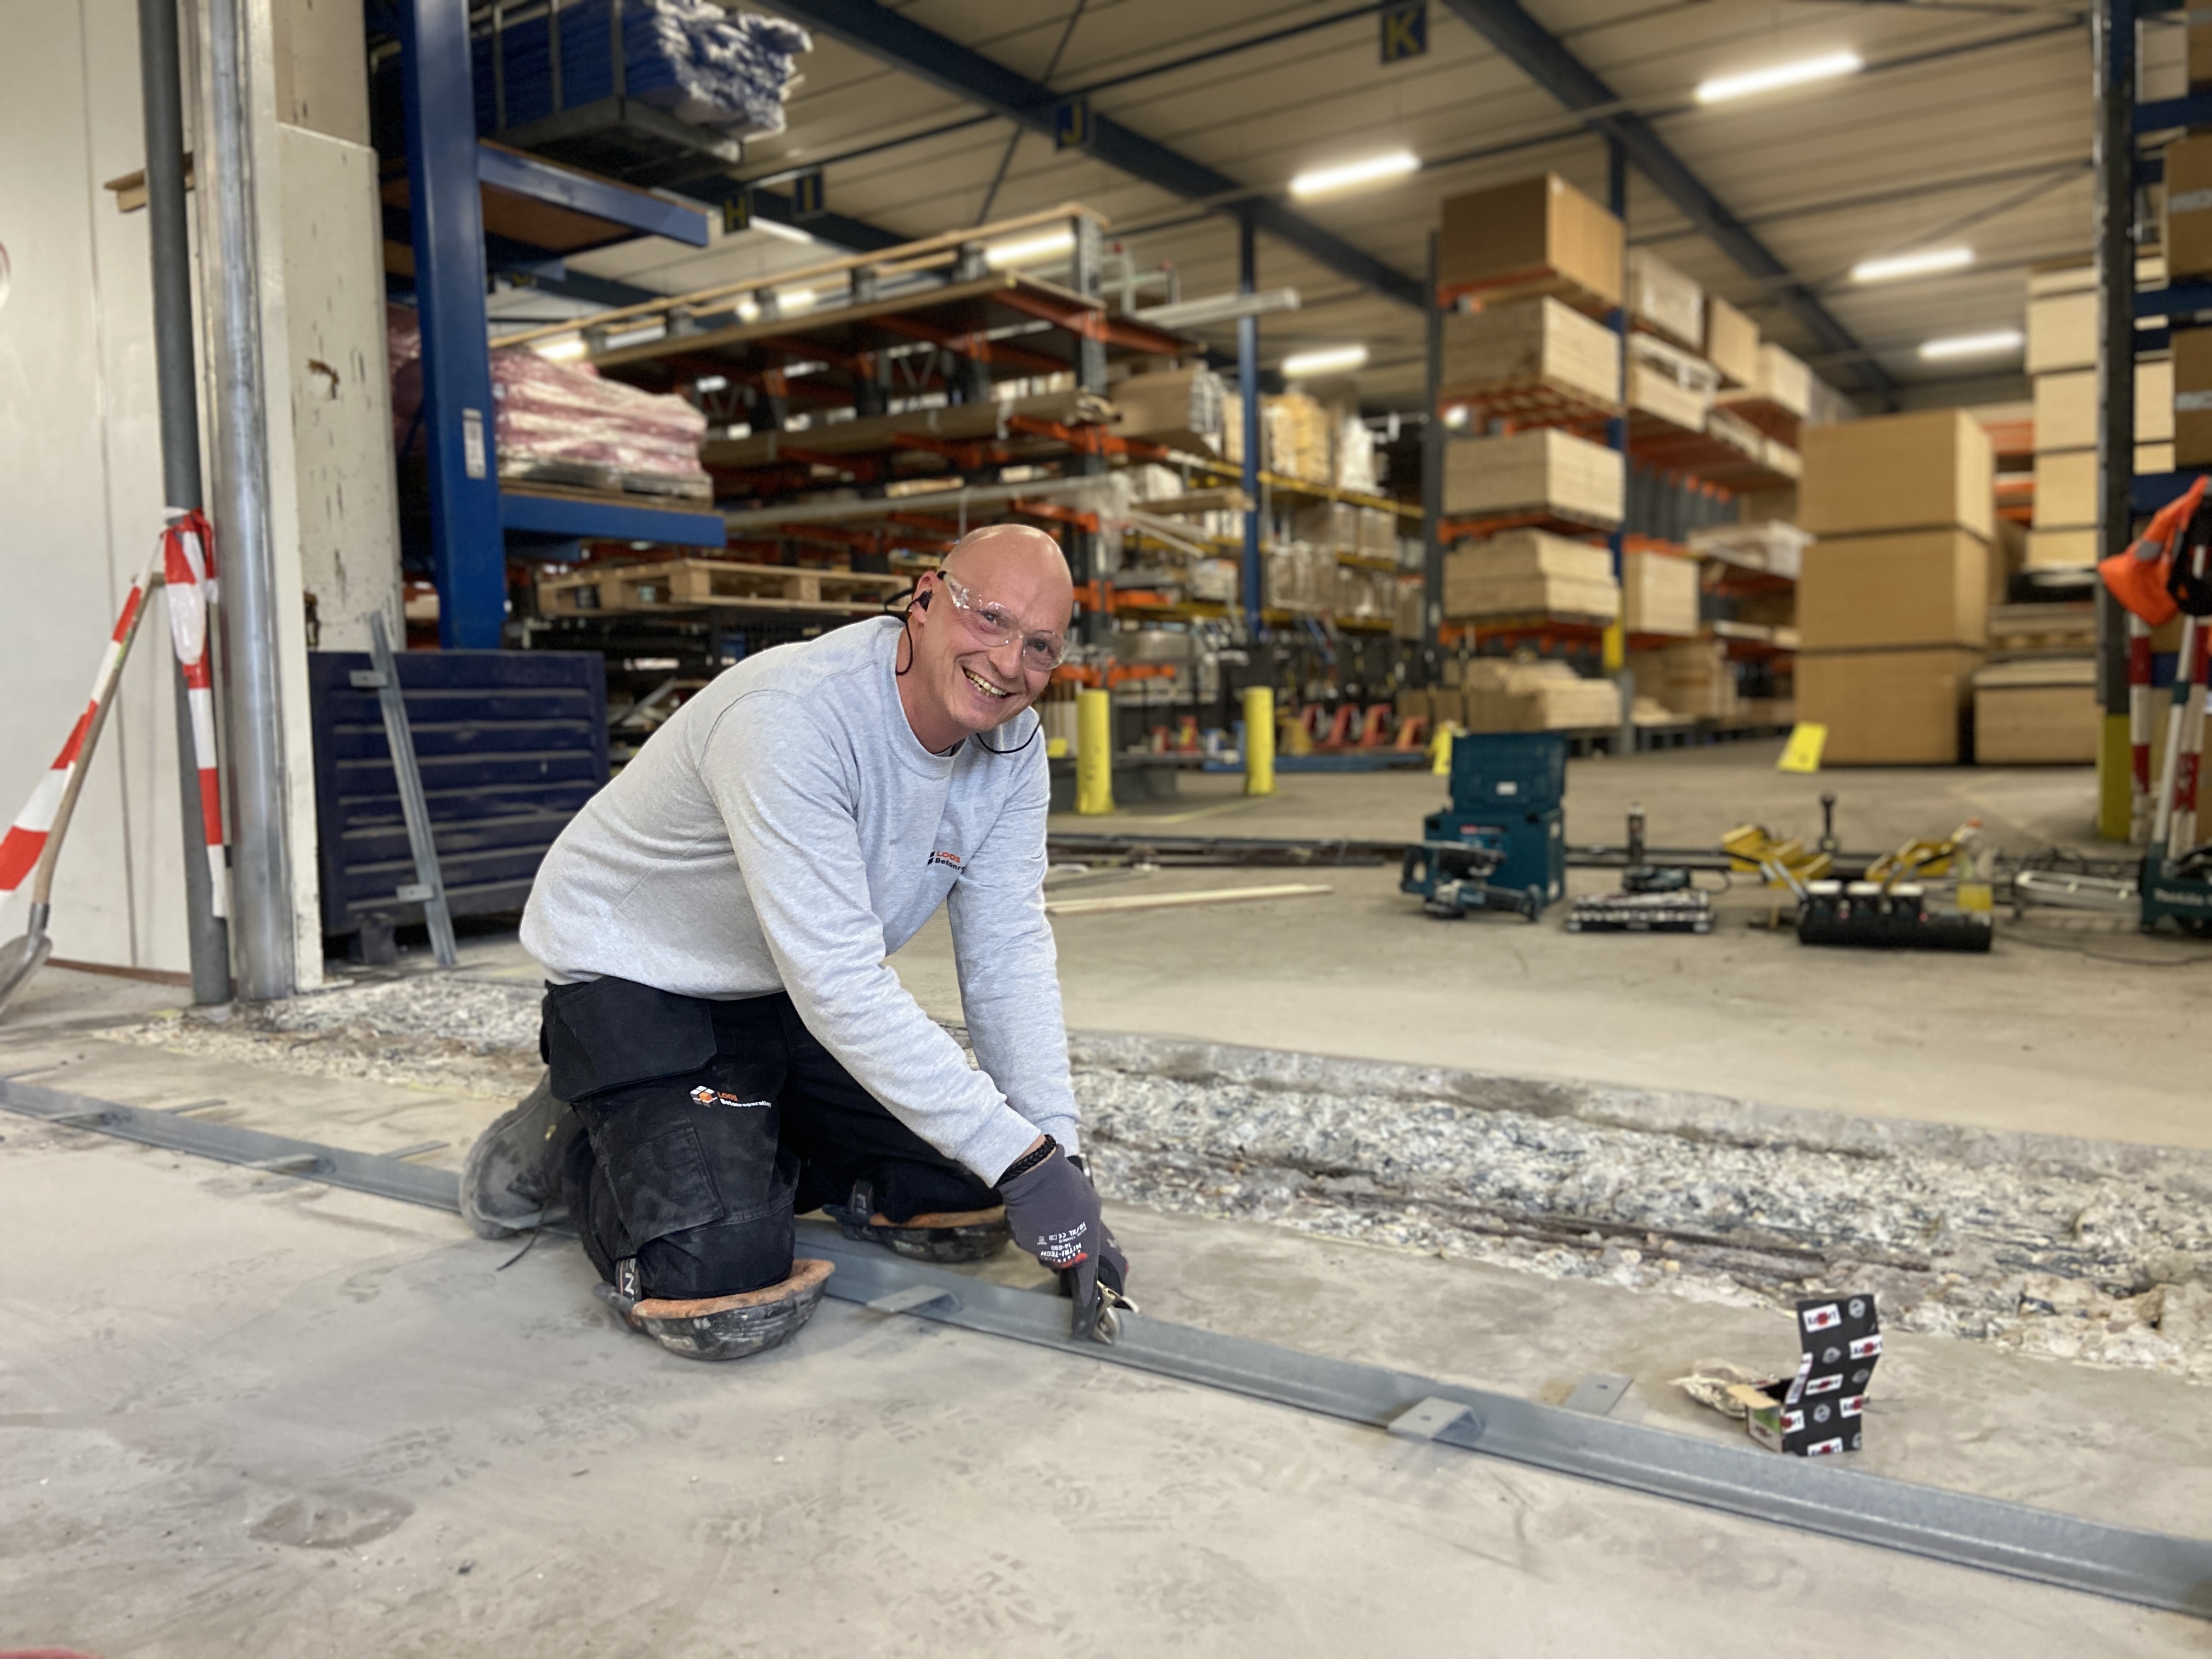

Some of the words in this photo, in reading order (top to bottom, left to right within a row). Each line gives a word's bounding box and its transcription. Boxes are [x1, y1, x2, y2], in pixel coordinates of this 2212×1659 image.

[1387, 11, 1417, 57] K
[1062, 105, 1082, 144] J
[725, 198, 747, 231] H
[1069, 1221, 1086, 1236] 10/XL
[1040, 1242, 1081, 1258] NITRI-TECH
[1051, 1243, 1071, 1251] 14-690
